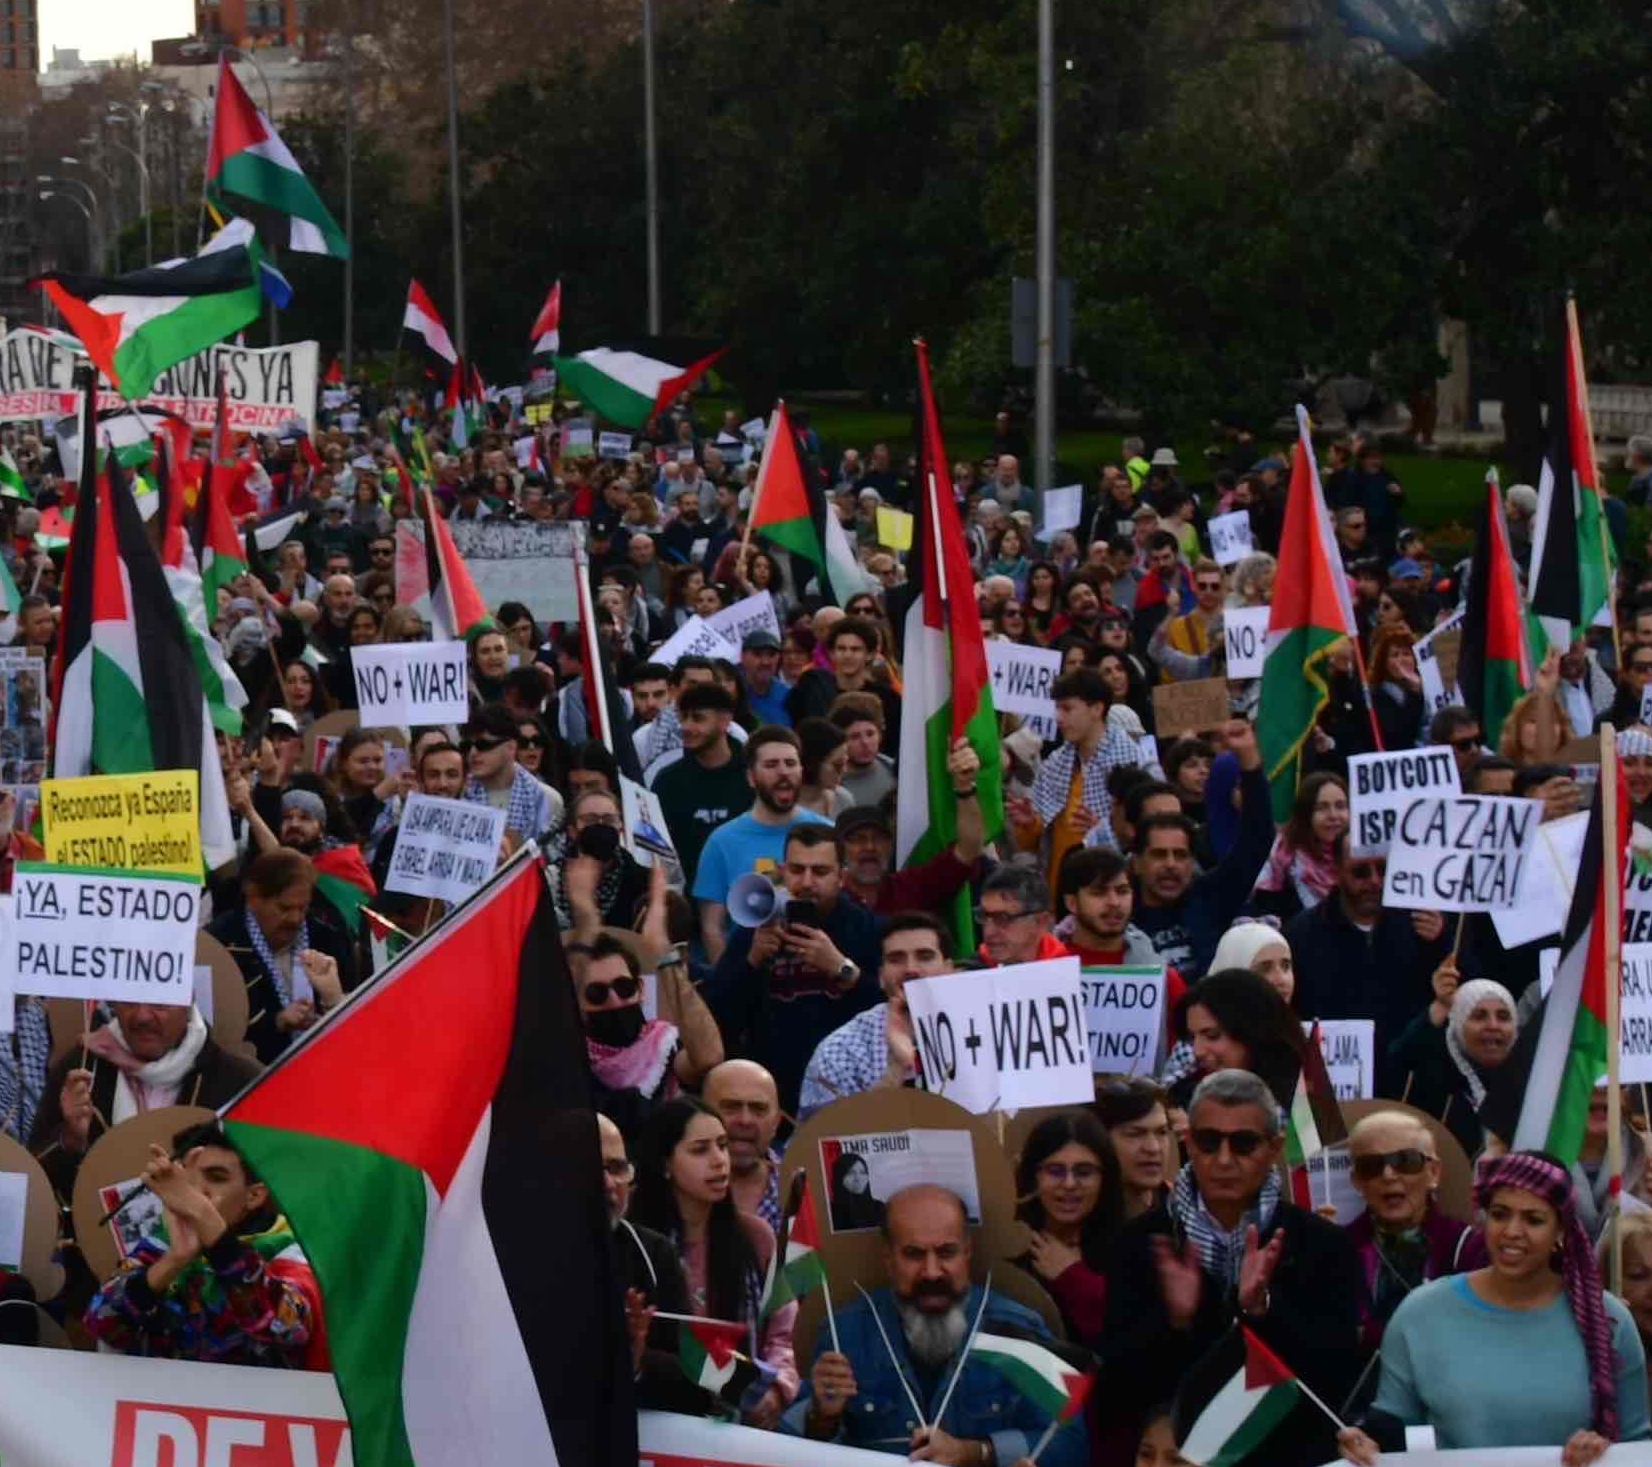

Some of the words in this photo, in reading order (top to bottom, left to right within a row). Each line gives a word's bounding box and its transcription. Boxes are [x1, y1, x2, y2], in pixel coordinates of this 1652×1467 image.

[258, 351, 294, 404] YA
[1229, 625, 1256, 658] NO
[358, 665, 388, 704] NO
[407, 660, 465, 702] WAR!
[1357, 754, 1454, 795] BOYCOTT
[144, 781, 192, 818] España
[1400, 800, 1531, 851] CAZAN
[15, 877, 65, 919] ¡YA,
[78, 884, 194, 925] ESTADO
[1392, 868, 1425, 897] en
[1433, 854, 1517, 907] GAZA!
[17, 943, 184, 984] PALESTINO!
[1081, 983, 1158, 1010] STADO
[917, 1013, 955, 1090] NO
[964, 1022, 982, 1064] +
[989, 995, 1085, 1072] WAR!
